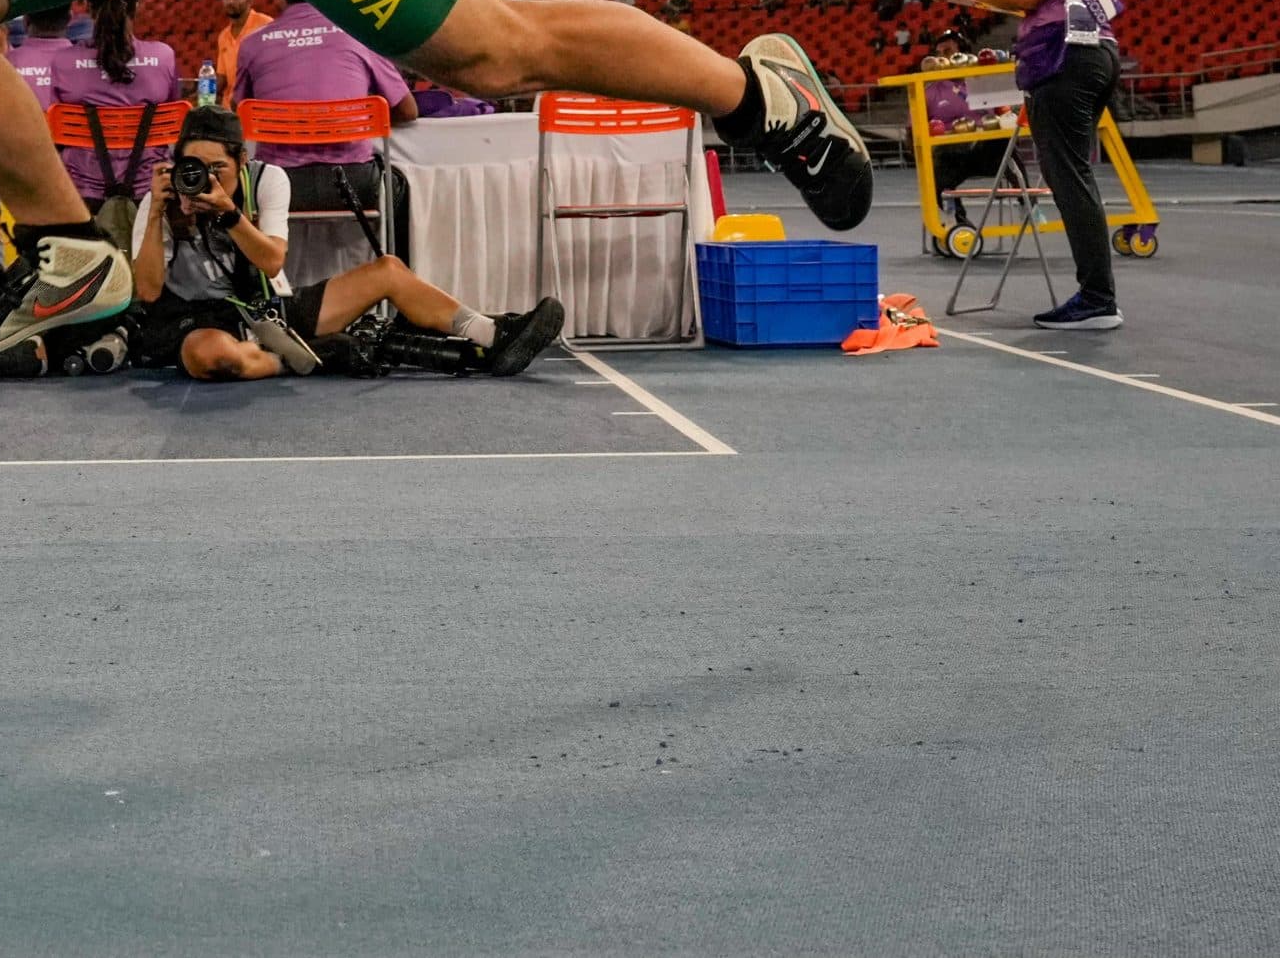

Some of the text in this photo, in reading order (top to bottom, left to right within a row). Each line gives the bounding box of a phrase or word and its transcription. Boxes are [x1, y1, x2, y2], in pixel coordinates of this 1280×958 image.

[261, 25, 344, 42] NEW DELH
[287, 36, 323, 48] 2025
[76, 59, 98, 69] NE
[36, 77, 52, 86] 20
